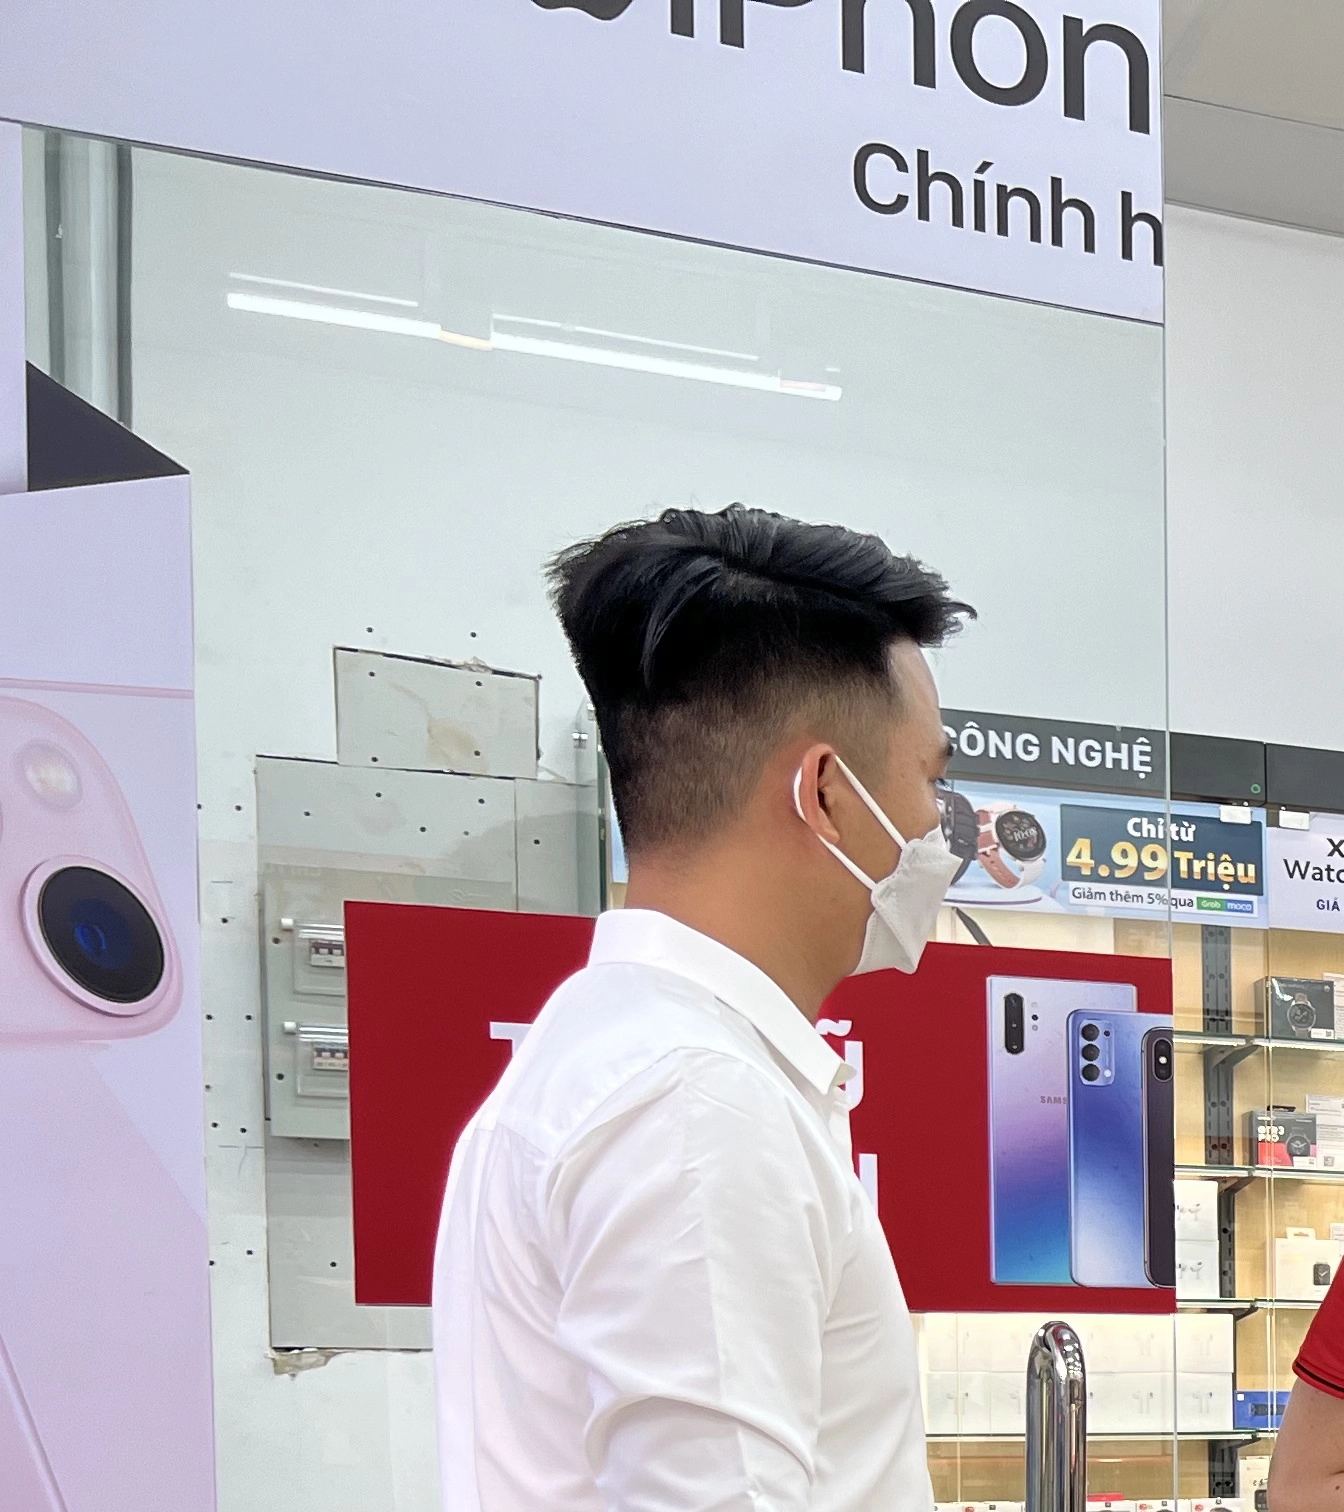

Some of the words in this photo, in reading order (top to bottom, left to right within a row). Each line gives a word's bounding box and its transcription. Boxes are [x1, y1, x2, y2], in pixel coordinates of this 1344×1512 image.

[853, 142, 1096, 255] Chính
[1051, 736, 1153, 779] NGHỆ
[1126, 816, 1164, 841] Chỉ
[1168, 820, 1197, 842] từ
[1065, 837, 1168, 882] 4.99
[1173, 850, 1256, 891] Triệu
[1072, 886, 1106, 904] Giảm
[1109, 889, 1144, 905] thêm
[1147, 893, 1168, 907] 5%
[1170, 898, 1194, 912] qua
[1316, 896, 1341, 912] GIÁ
